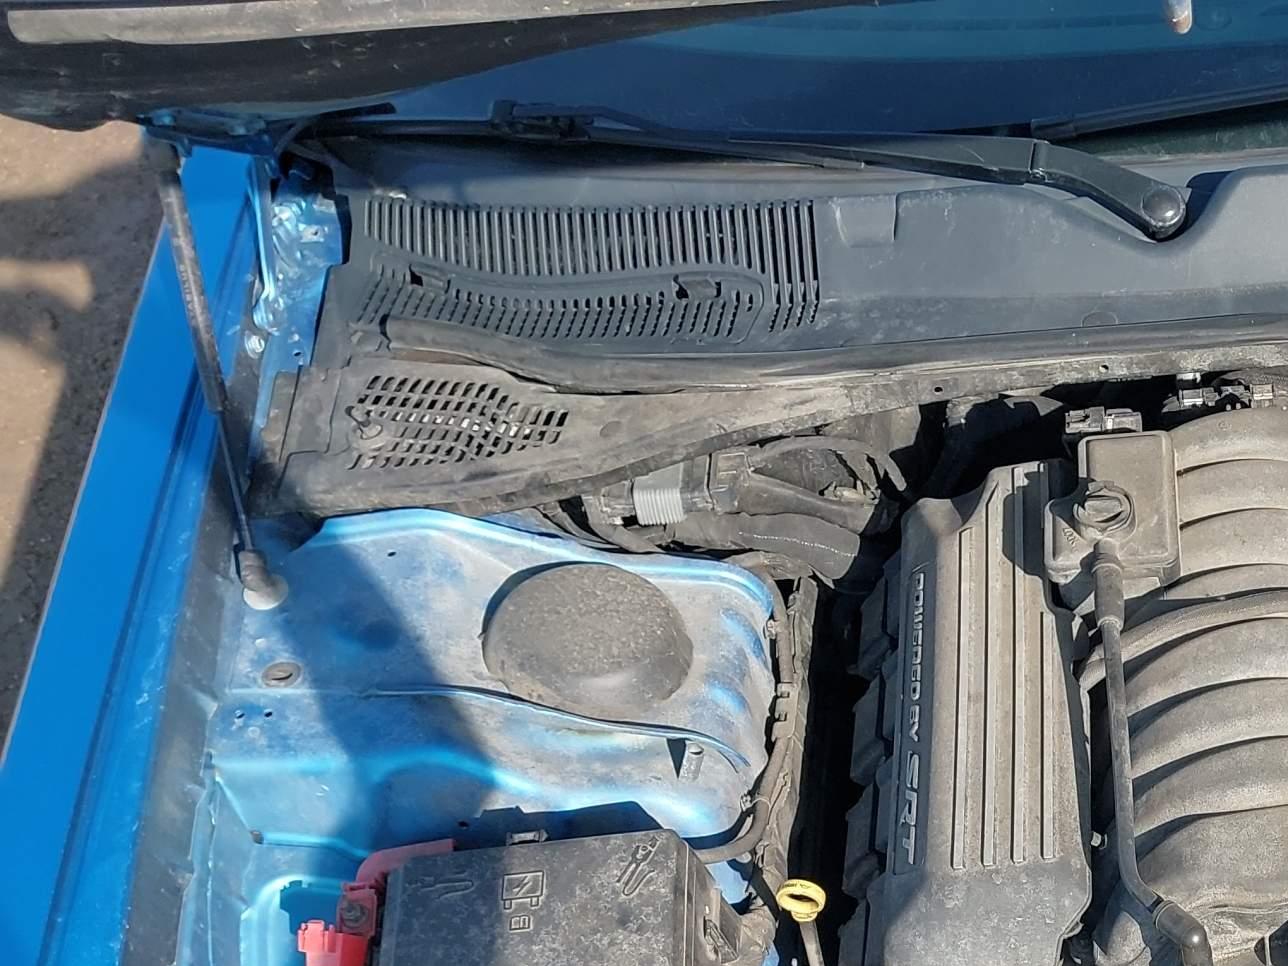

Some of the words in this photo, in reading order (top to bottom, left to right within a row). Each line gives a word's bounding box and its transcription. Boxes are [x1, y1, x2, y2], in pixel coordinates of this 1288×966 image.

[911, 572, 925, 701] POWERED
[908, 703, 921, 743] BY
[900, 750, 920, 866] SRT
